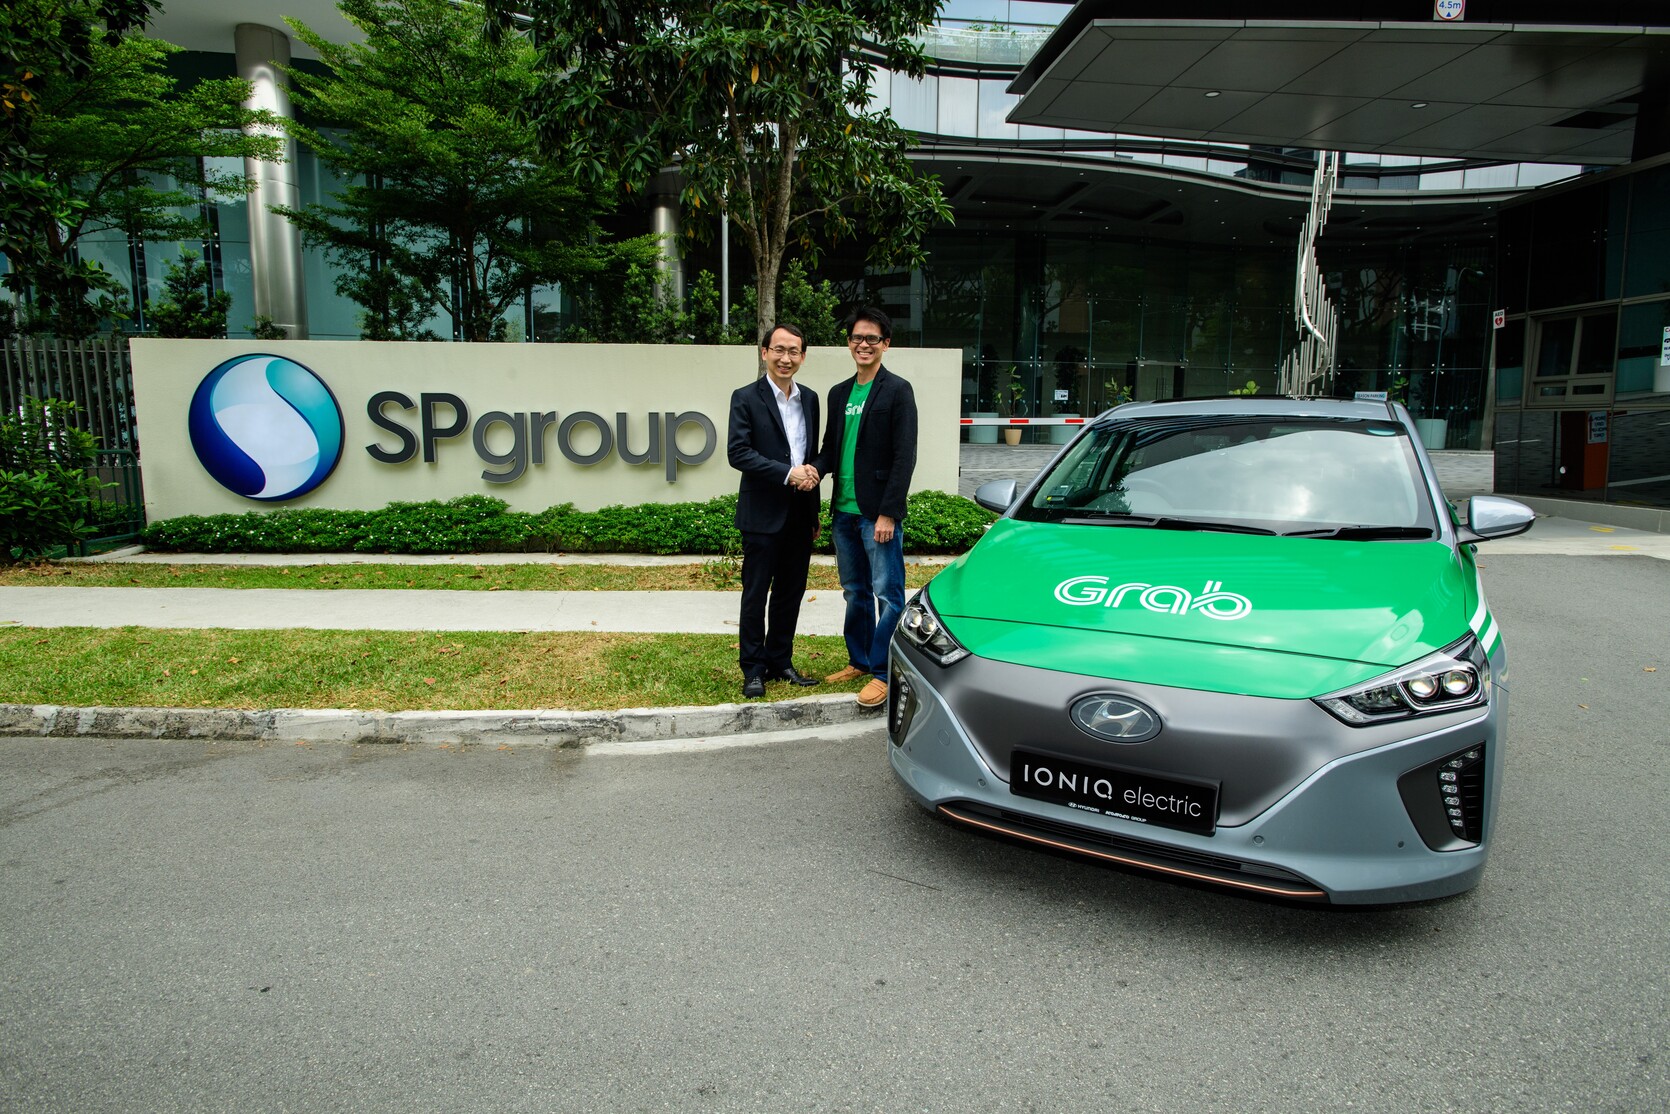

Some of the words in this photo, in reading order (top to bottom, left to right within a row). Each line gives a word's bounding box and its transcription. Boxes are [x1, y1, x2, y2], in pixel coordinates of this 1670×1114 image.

[1438, 1, 1461, 9] 4.5m
[1054, 575, 1253, 621] Grab
[1024, 764, 1113, 800] IONIQ
[1123, 786, 1202, 817] electric
[1077, 804, 1100, 813] HYUNDAI
